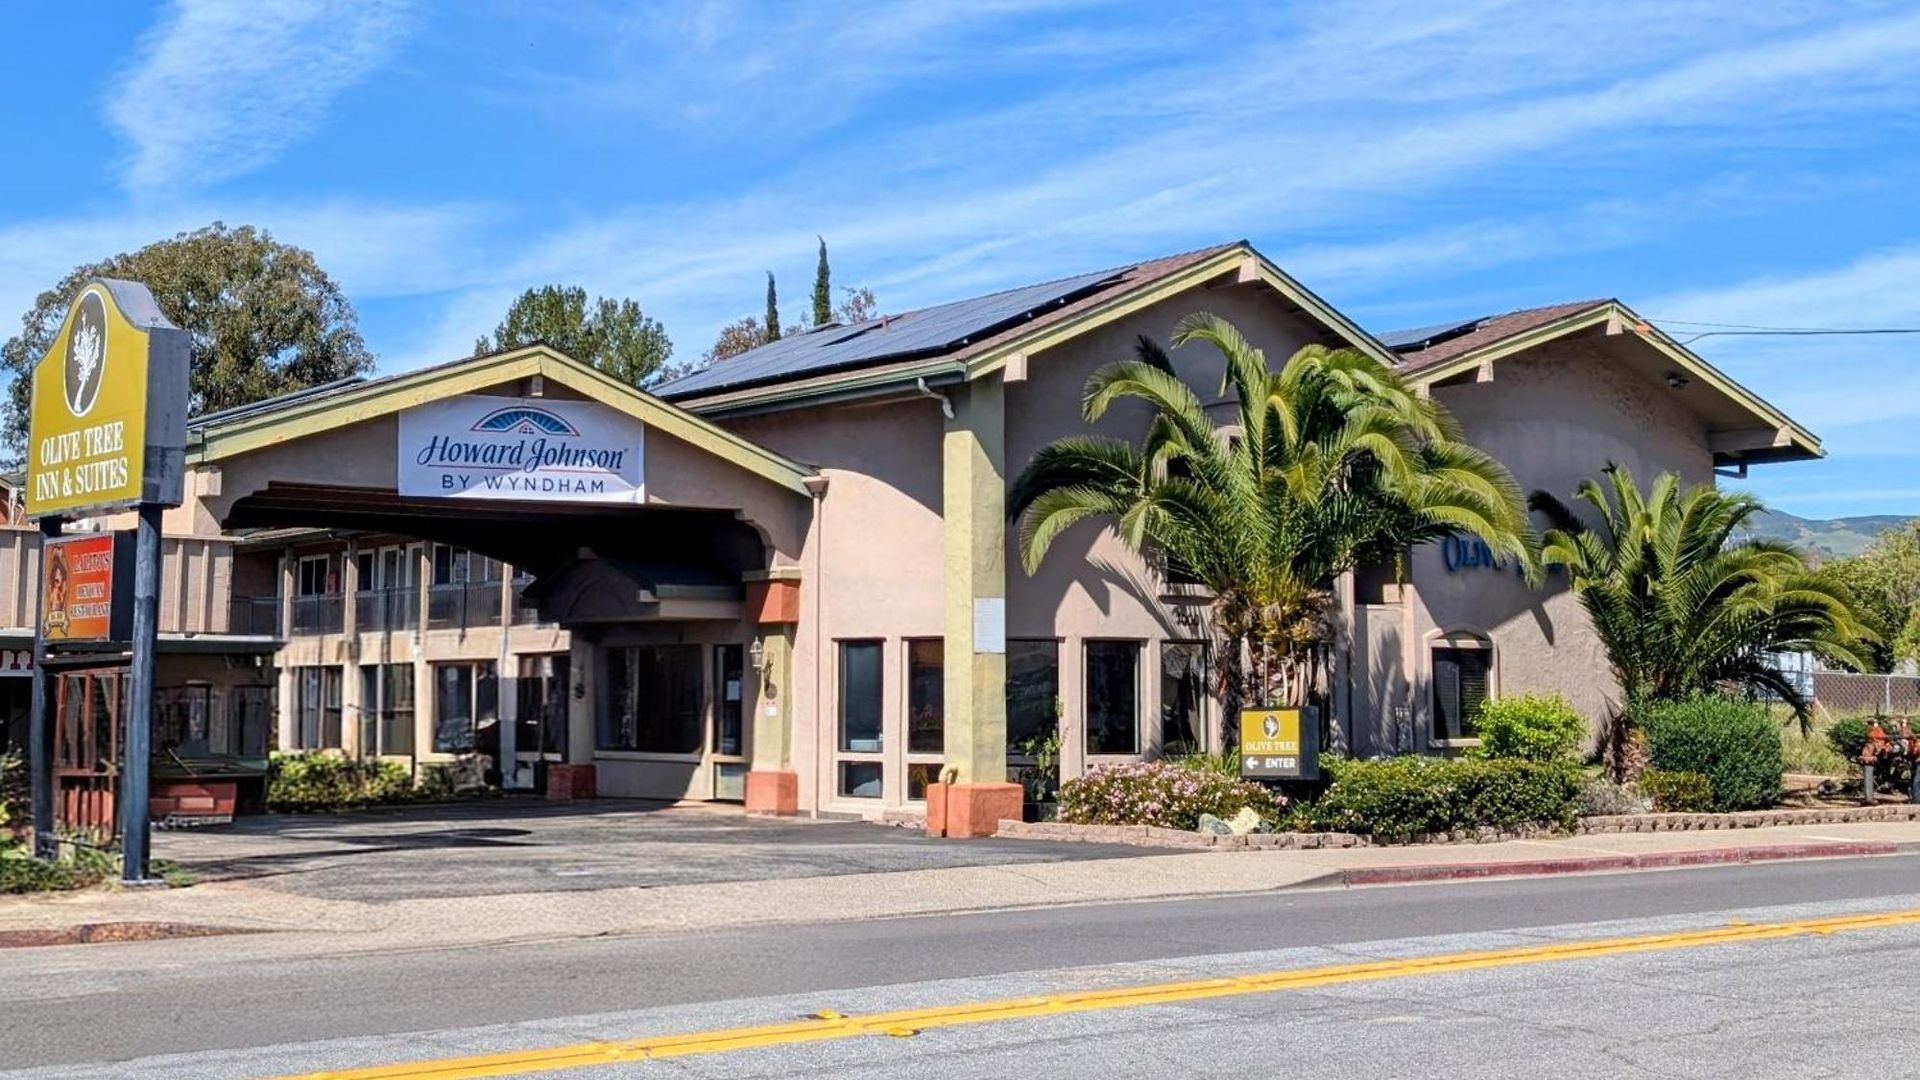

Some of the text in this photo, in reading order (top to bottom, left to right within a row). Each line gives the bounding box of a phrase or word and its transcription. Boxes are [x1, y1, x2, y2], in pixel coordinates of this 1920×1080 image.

[41, 421, 124, 466] OLIVE TREE
[417, 435, 623, 473] Howard Johnson
[36, 457, 128, 501] INN & SUITES
[442, 474, 604, 494] BY WYNDHAM
[1246, 741, 1298, 751] OLIVE TREE
[1265, 757, 1296, 768] ENTER
